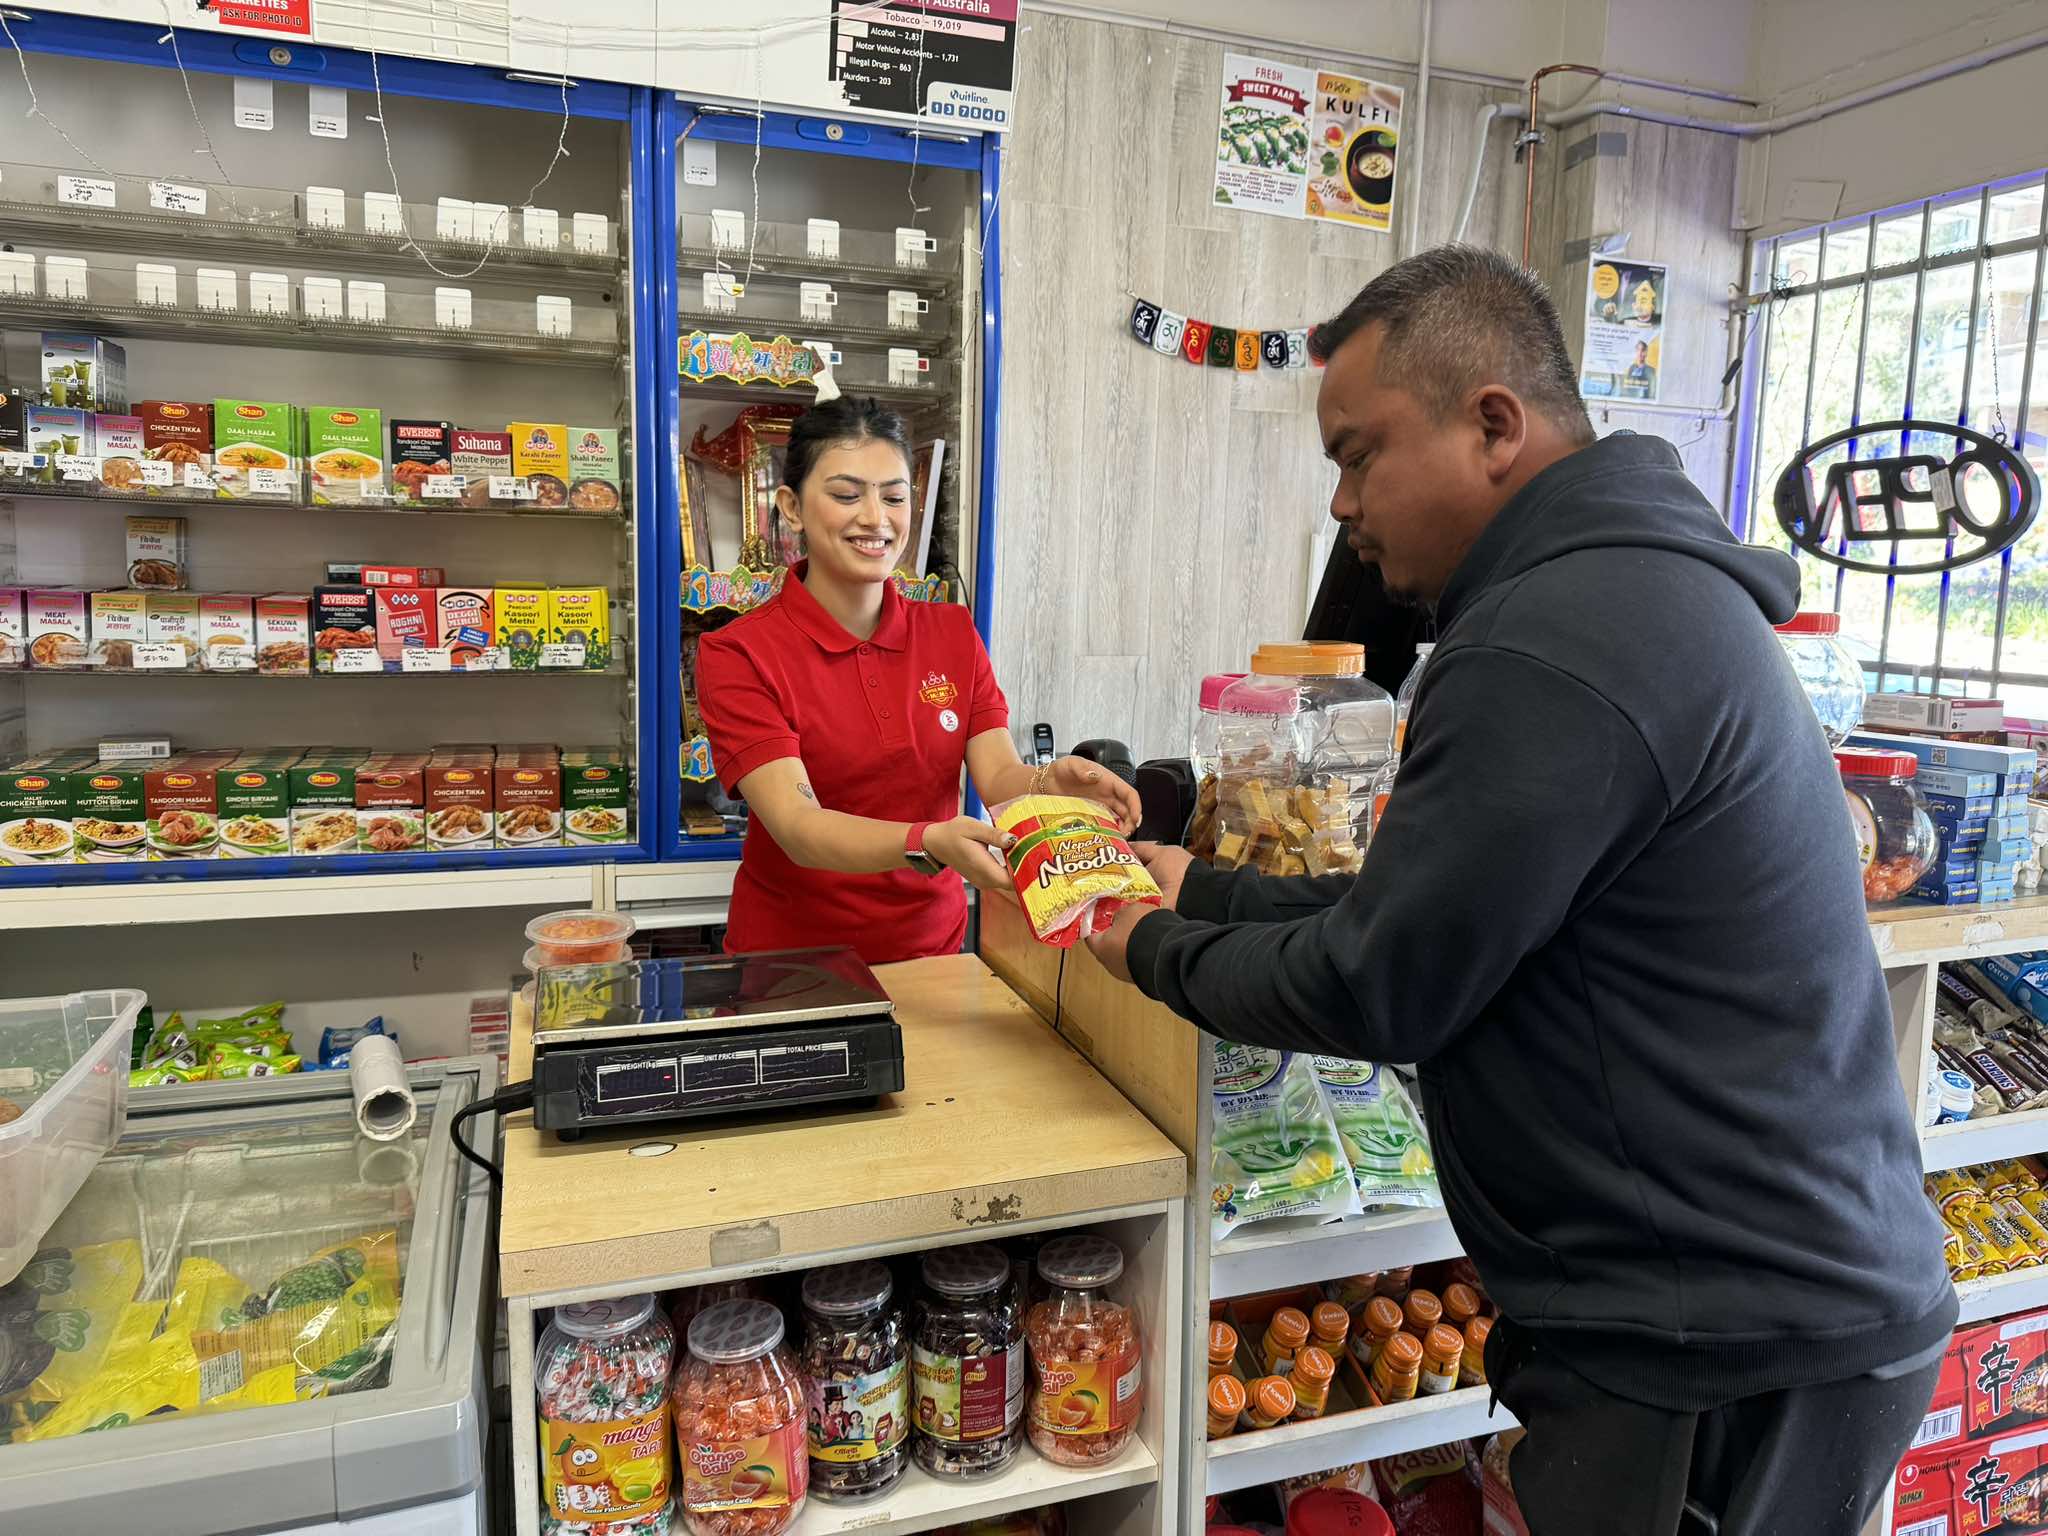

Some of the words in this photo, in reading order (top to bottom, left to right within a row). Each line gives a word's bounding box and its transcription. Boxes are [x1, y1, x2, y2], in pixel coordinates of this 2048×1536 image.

[932, 0, 991, 14] Australia
[223, 8, 240, 18] ASK
[243, 10, 260, 21] FOR
[262, 13, 290, 24] PHOTO
[293, 16, 302, 26] ID
[885, 12, 920, 25] Tobacco
[932, 19, 962, 32] 19,019
[870, 27, 896, 38] Alcohol
[855, 41, 875, 51] Motor
[877, 44, 901, 54] Vehicle
[902, 48, 933, 60] Accidents
[941, 53, 959, 63] 1,731
[849, 56, 871, 68] Illegal
[872, 59, 891, 70] Drugs
[899, 63, 912, 73] 863
[843, 72, 870, 83] Murders
[878, 76, 892, 86] 203
[1256, 67, 1283, 82] FRESH
[950, 89, 988, 104] Quitline
[1243, 82, 1270, 96] SWEET
[1272, 87, 1295, 102] PAAN
[1326, 97, 1389, 124] KULFI
[163, 405, 187, 416] Shan
[238, 406, 263, 417] Shan
[332, 414, 358, 424] Shan
[150, 424, 181, 433] CHICKEN
[182, 425, 201, 434] TIKKA
[226, 428, 246, 436] DAAL
[246, 429, 276, 438] MASALA
[399, 427, 442, 439] EVEREST
[112, 435, 132, 443] MEAT
[322, 434, 340, 443] DAAL
[341, 434, 370, 444] MASALA
[396, 438, 420, 446] Tandoori
[420, 440, 442, 448] Chicken
[458, 434, 502, 452] Suhana
[106, 442, 138, 450] MASALA
[520, 450, 541, 460] Karahi
[541, 452, 562, 460] Paneer
[570, 454, 590, 463] Shahi
[590, 455, 614, 464] Paneer
[453, 455, 479, 464] White
[480, 456, 509, 467] Pepper
[322, 594, 367, 606] EVEREST
[444, 599, 477, 609] MDH
[505, 595, 538, 603] MDH
[558, 595, 592, 604] MDH
[320, 606, 343, 614] Tandoori
[447, 608, 479, 620] DEGGI
[504, 610, 540, 619] Kasoori
[558, 610, 592, 620] Kasoori
[40, 618, 72, 626] MASALA
[390, 615, 422, 628] ROGHNI
[448, 617, 480, 628] MIRCH
[238, 776, 264, 785] Shan
[311, 775, 337, 784] Shan
[447, 772, 473, 782] Shan
[516, 772, 540, 782] Shan
[585, 770, 607, 780] Shan
[18, 779, 45, 788] Shan
[92, 778, 120, 788] Shan
[167, 776, 194, 786] Shan
[464, 788, 486, 796] TIKKA
[596, 786, 620, 794] BIRYANI
[0, 799, 36, 807] CHICKEN
[76, 798, 108, 806] MUTTON
[109, 798, 138, 806] BIRYANI
[185, 796, 212, 804] MASALA
[225, 796, 250, 804] SINDHI
[250, 795, 278, 803] BIRYANI
[1058, 834, 1106, 854] Nepali
[786, 1046, 804, 1054] TOTAL
[804, 1044, 822, 1053] PRICE
[704, 1055, 718, 1063] UNIT
[718, 1052, 738, 1062] PRICE
[620, 1060, 658, 1072] WEIGHT(kg)
[1974, 1053, 2014, 1090] SNICKERS
[1944, 1344, 1974, 1359] NGSHIM
[1041, 1371, 1076, 1386] ange
[1977, 1341, 2019, 1416] 辛
[1041, 1382, 1061, 1395] all
[602, 1415, 664, 1446] mango
[632, 1440, 664, 1459] TART
[690, 1446, 745, 1466] Orange
[700, 1462, 731, 1477] Ball
[1919, 1458, 1960, 1475] NONGSHIM
[1963, 1456, 2010, 1527] 辛
[622, 1503, 641, 1511] Candy
